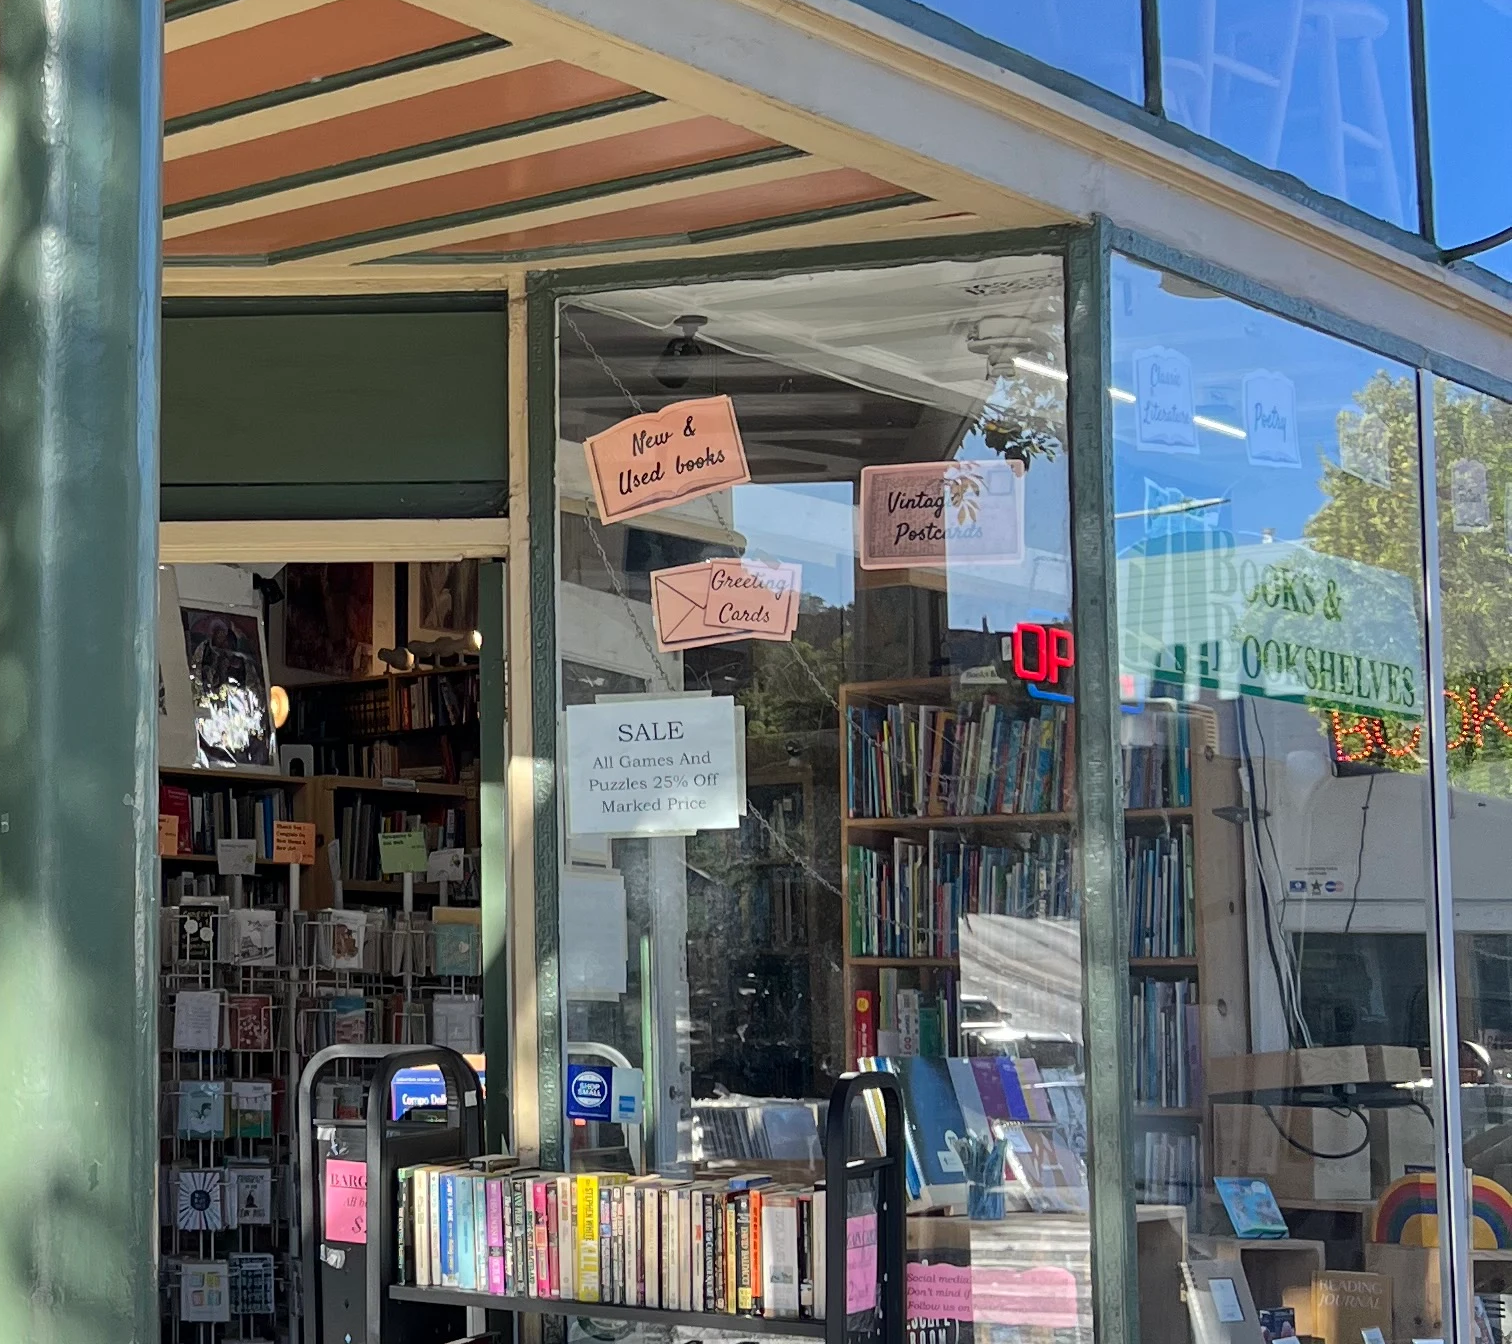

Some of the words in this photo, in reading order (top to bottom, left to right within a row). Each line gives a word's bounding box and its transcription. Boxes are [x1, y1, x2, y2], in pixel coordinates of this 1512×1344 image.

[1254, 400, 1287, 444] Poetry
[632, 430, 675, 459] New
[681, 416, 699, 438] &
[618, 464, 666, 497] Used
[674, 446, 727, 477] books
[886, 489, 951, 518] Vintag
[894, 521, 984, 546] Postcards
[710, 568, 788, 597] Greeting
[1323, 578, 1344, 623] &
[718, 603, 771, 625] Cards
[617, 721, 684, 742] SALE
[592, 753, 614, 768] All
[618, 753, 673, 768] Games
[676, 750, 712, 766] And
[588, 776, 648, 792] Puzzles
[652, 773, 689, 791] 25%
[693, 771, 719, 789] Off
[601, 797, 662, 814] Marked
[667, 796, 707, 813] Price
[579, 1082, 601, 1090] SHOP
[584, 1187, 594, 1218] STEPHEN
[584, 1219, 594, 1241] WHITE
[580, 1271, 597, 1292] ME
[907, 1272, 937, 1284] Social
[1319, 1278, 1383, 1296] READING
[907, 1287, 934, 1299] Don't
[935, 1286, 961, 1298] mind
[1317, 1293, 1381, 1310] JOURNAL
[907, 1301, 941, 1313] Follow
[943, 1303, 956, 1313] us
[957, 1304, 971, 1313] on
